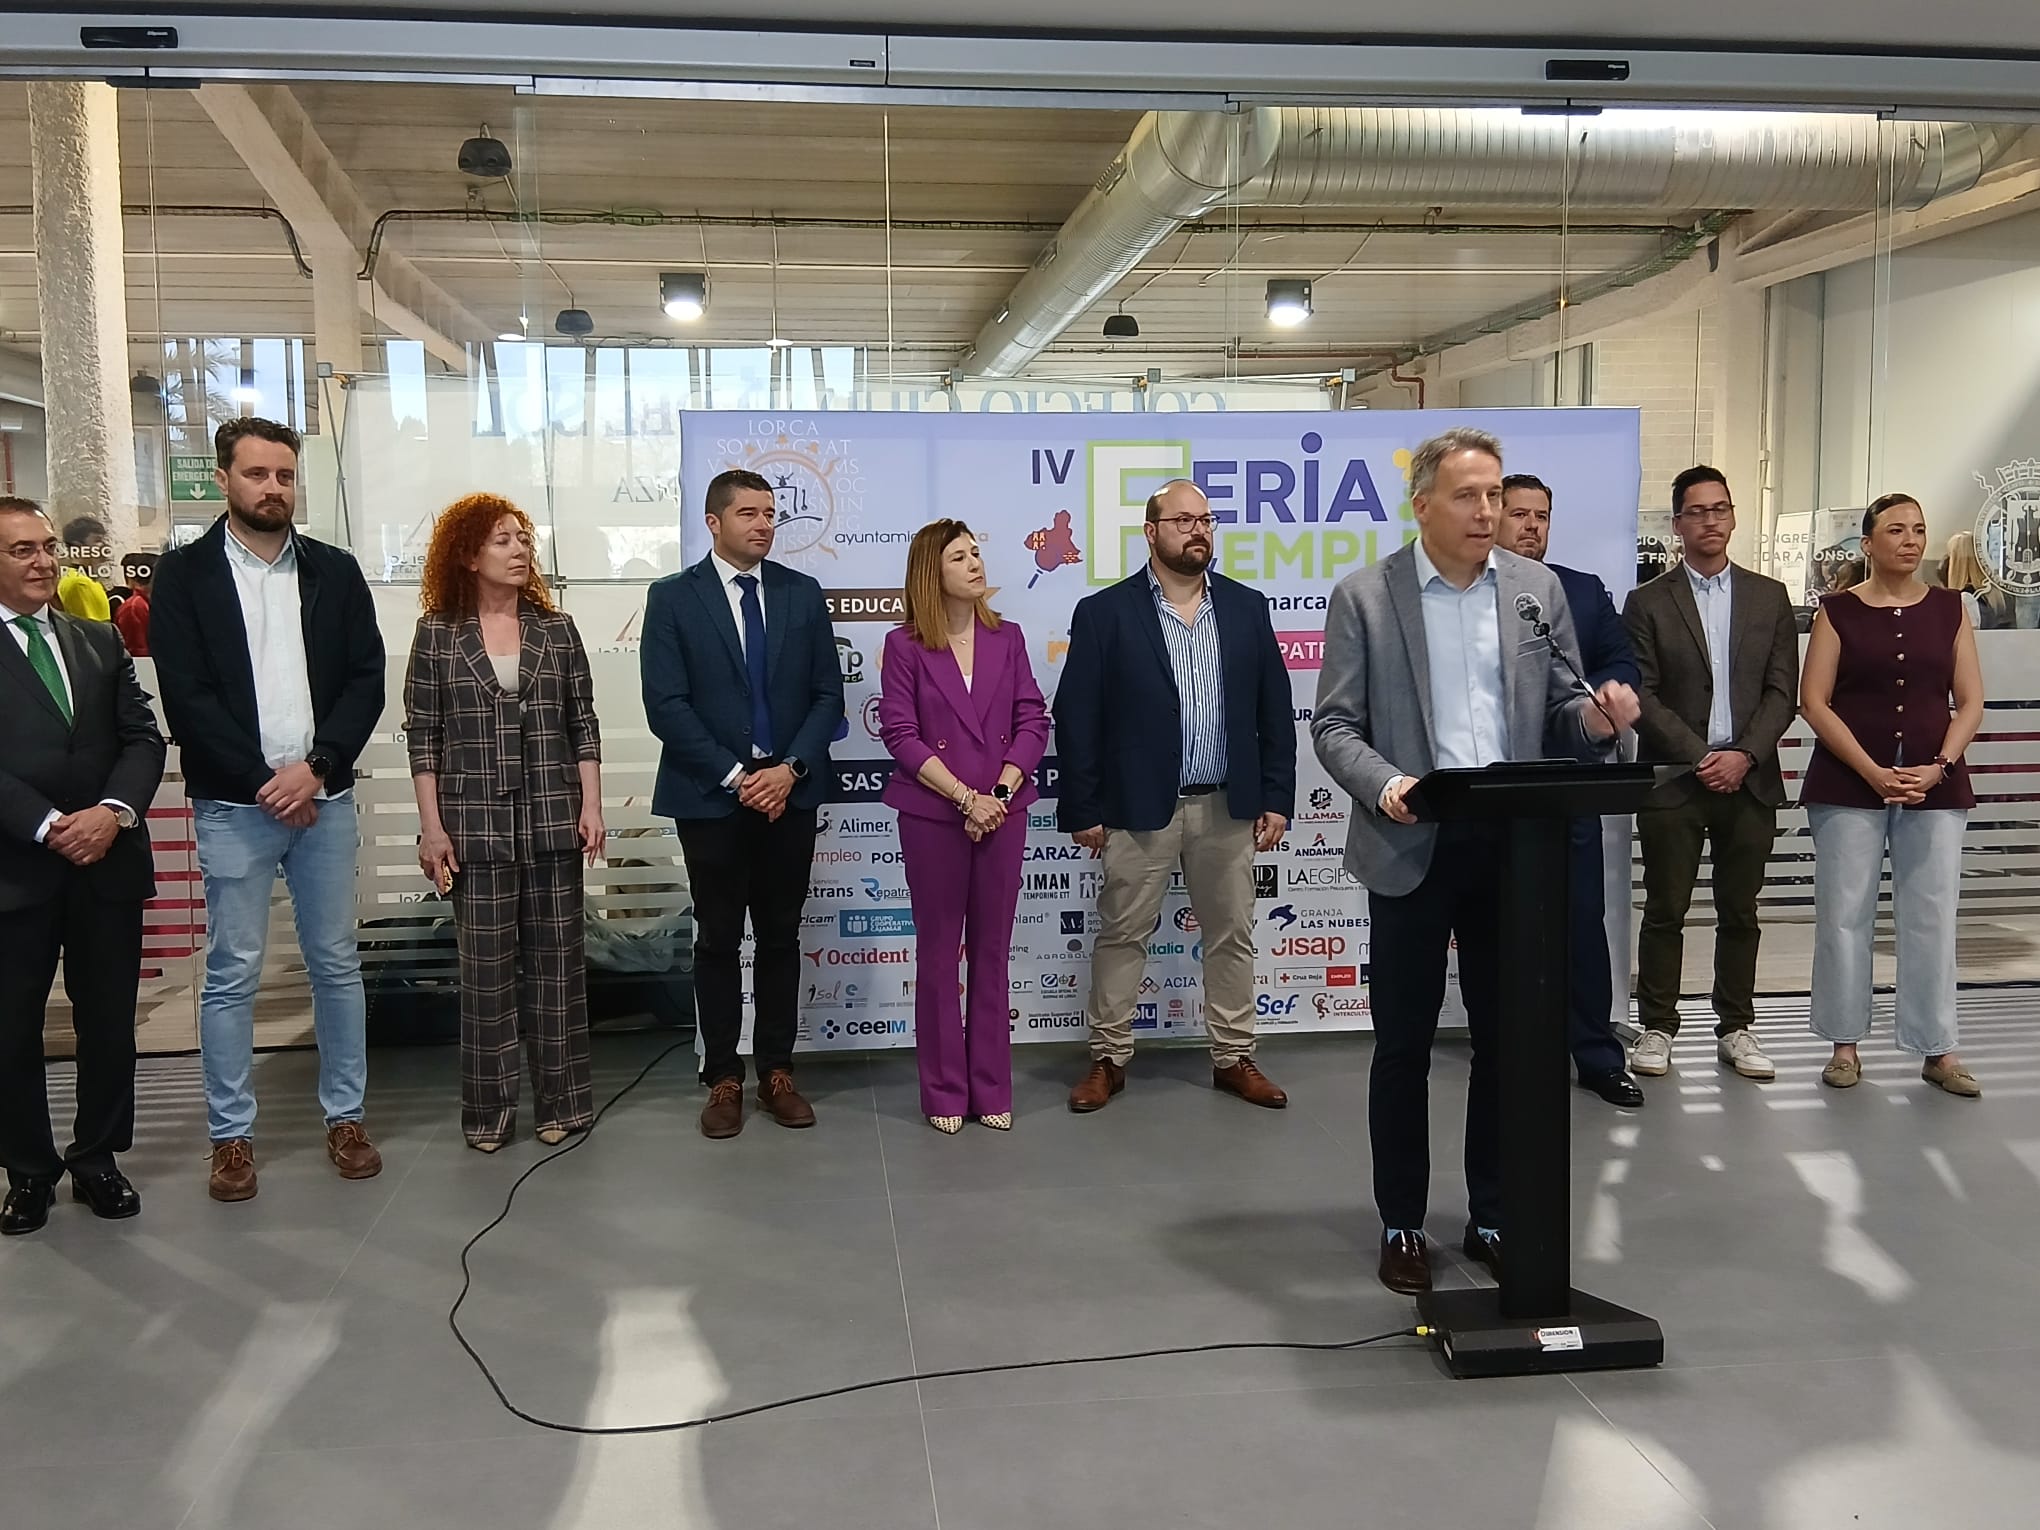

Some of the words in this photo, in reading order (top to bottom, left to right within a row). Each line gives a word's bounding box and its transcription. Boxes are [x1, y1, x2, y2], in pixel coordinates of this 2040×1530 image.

[749, 420, 819, 436] LORCA
[177, 459, 204, 469] SALIDA
[1031, 448, 1076, 485] IV
[173, 472, 216, 482] EMERGENC
[840, 772, 883, 791] SAS
[1298, 812, 1345, 820] LLAMAS
[1295, 847, 1344, 857] ANDAMUR
[1023, 892, 1058, 900] TEMPORING
[1059, 891, 1070, 899] ETT
[1301, 908, 1343, 917] GRANJA
[1301, 920, 1324, 929] LAS
[1328, 918, 1370, 928] NUBES
[827, 947, 910, 966] Occident
[1163, 977, 1198, 988] ACIA
[1256, 994, 1300, 1015] Sef
[1028, 1009, 1084, 1029] amusal
